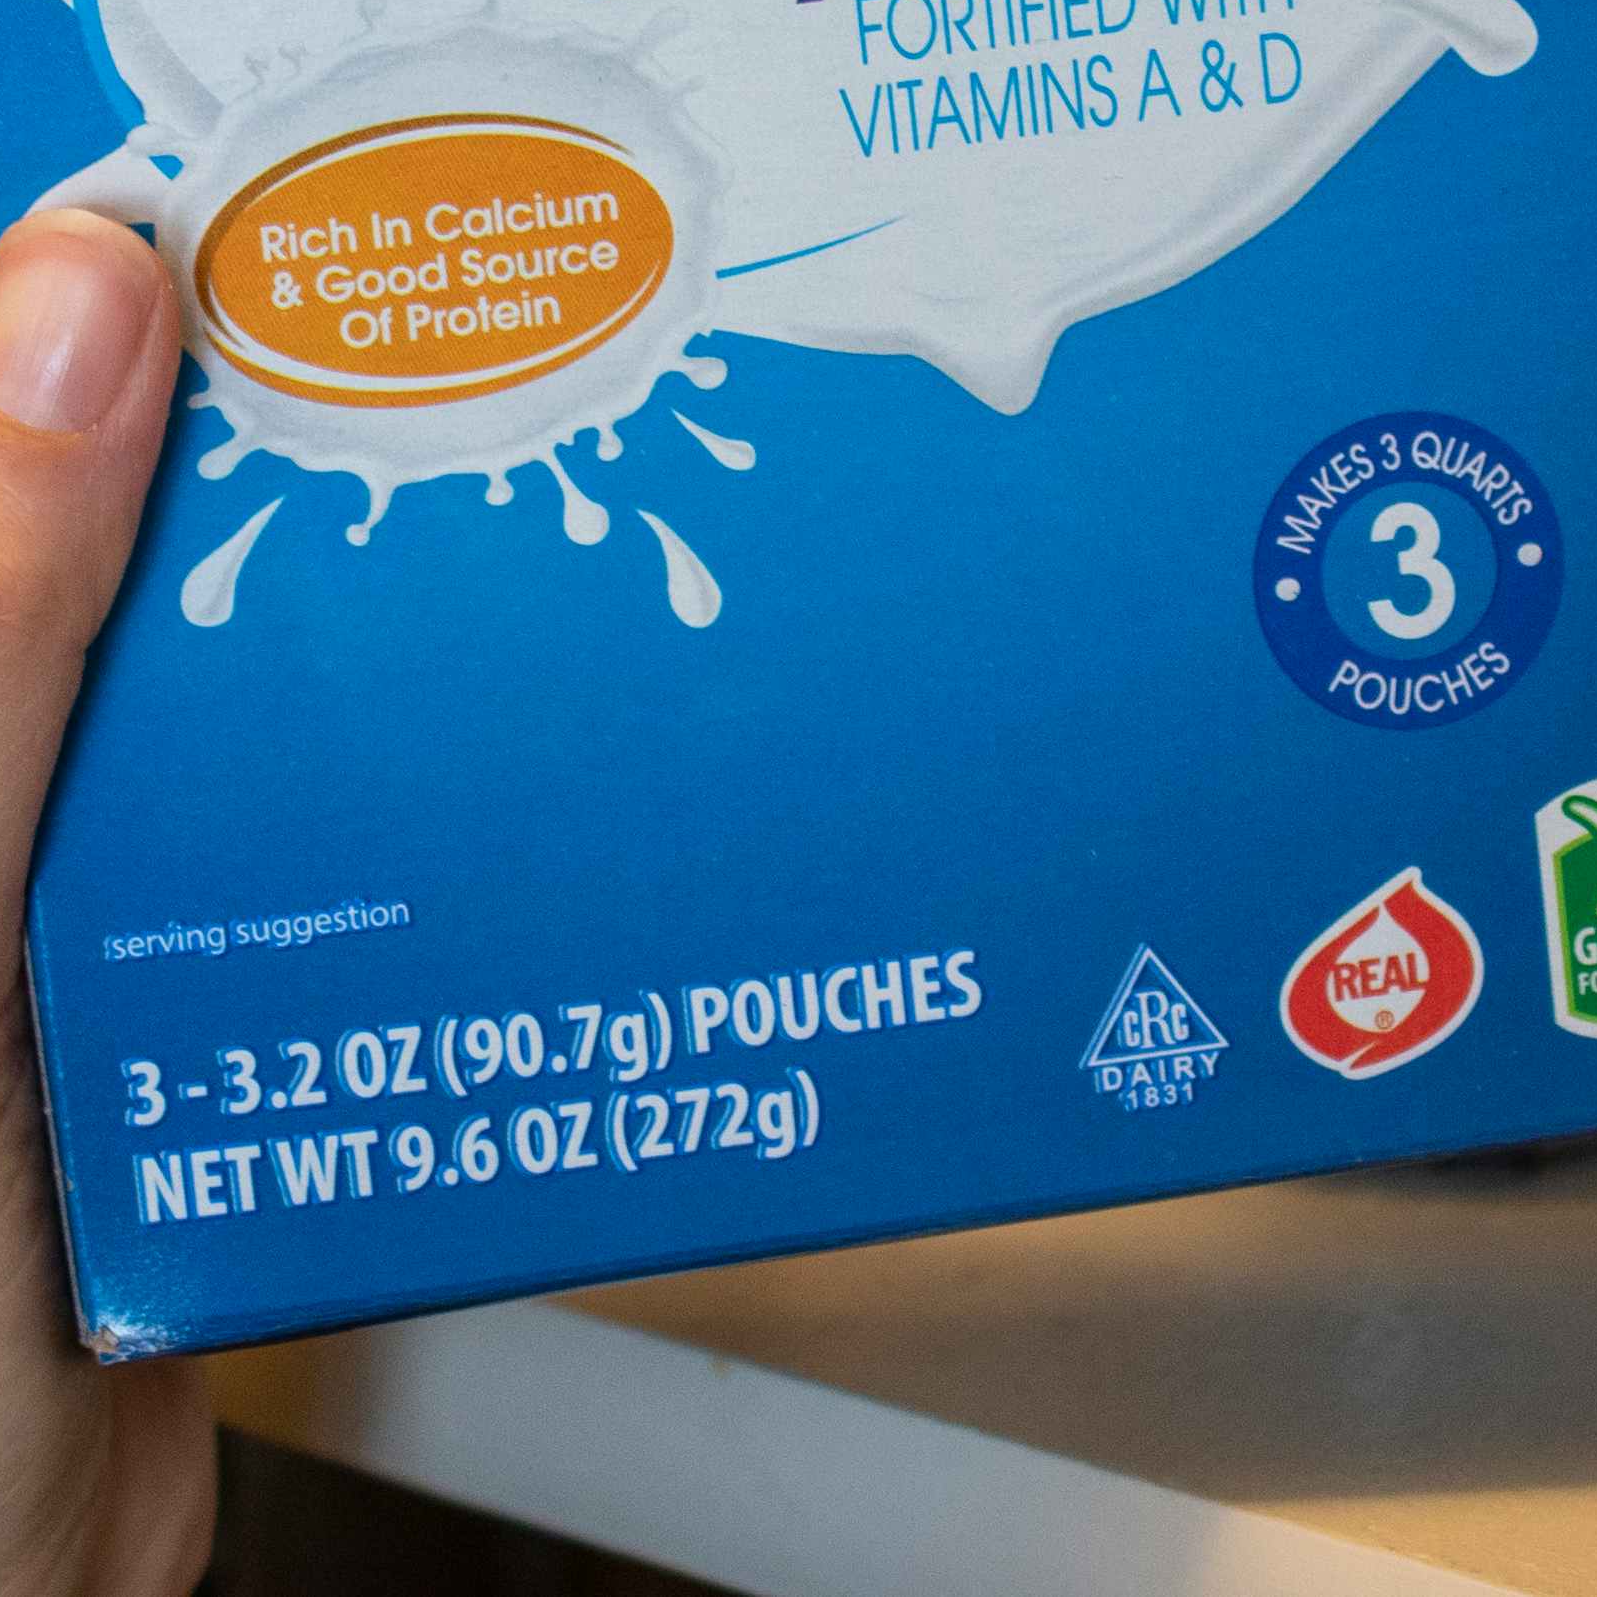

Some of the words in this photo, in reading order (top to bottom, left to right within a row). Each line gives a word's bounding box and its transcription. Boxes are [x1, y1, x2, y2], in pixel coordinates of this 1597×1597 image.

[839, 54, 1118, 158] VITAMINS
[1138, 48, 1182, 123] A
[1199, 39, 1244, 113] &
[1259, 32, 1302, 105] D
[260, 218, 359, 264] Rich
[372, 213, 412, 251] In
[425, 191, 620, 243] Calcium
[270, 270, 303, 311] &
[316, 256, 449, 303] Good
[461, 239, 619, 288] Source
[339, 306, 393, 350] Of
[406, 290, 561, 342] Protein
[1277, 443, 1375, 555] MAKES
[1380, 433, 1402, 469] 3
[1411, 431, 1534, 527] QUARTS
[1367, 501, 1456, 639] 3
[1328, 640, 1511, 715] POUCHES
[110, 922, 227, 961] serving
[235, 900, 411, 948] suggestion
[1331, 952, 1426, 999] REAL
[125, 1060, 166, 1127] 3
[221, 1041, 327, 1115] 3.2
[339, 1025, 427, 1099] OZ
[439, 992, 672, 1097] (90.7g)
[689, 949, 983, 1055] POUCHES
[1122, 991, 1189, 1049] CRC
[1102, 1051, 1219, 1091] DAIRY
[1127, 1082, 1193, 1109] 1831
[138, 1145, 261, 1224] NET
[273, 1129, 379, 1208] WT
[392, 1116, 499, 1193] 9.6
[514, 1102, 599, 1174] OZ
[610, 1068, 819, 1171] (272g)
